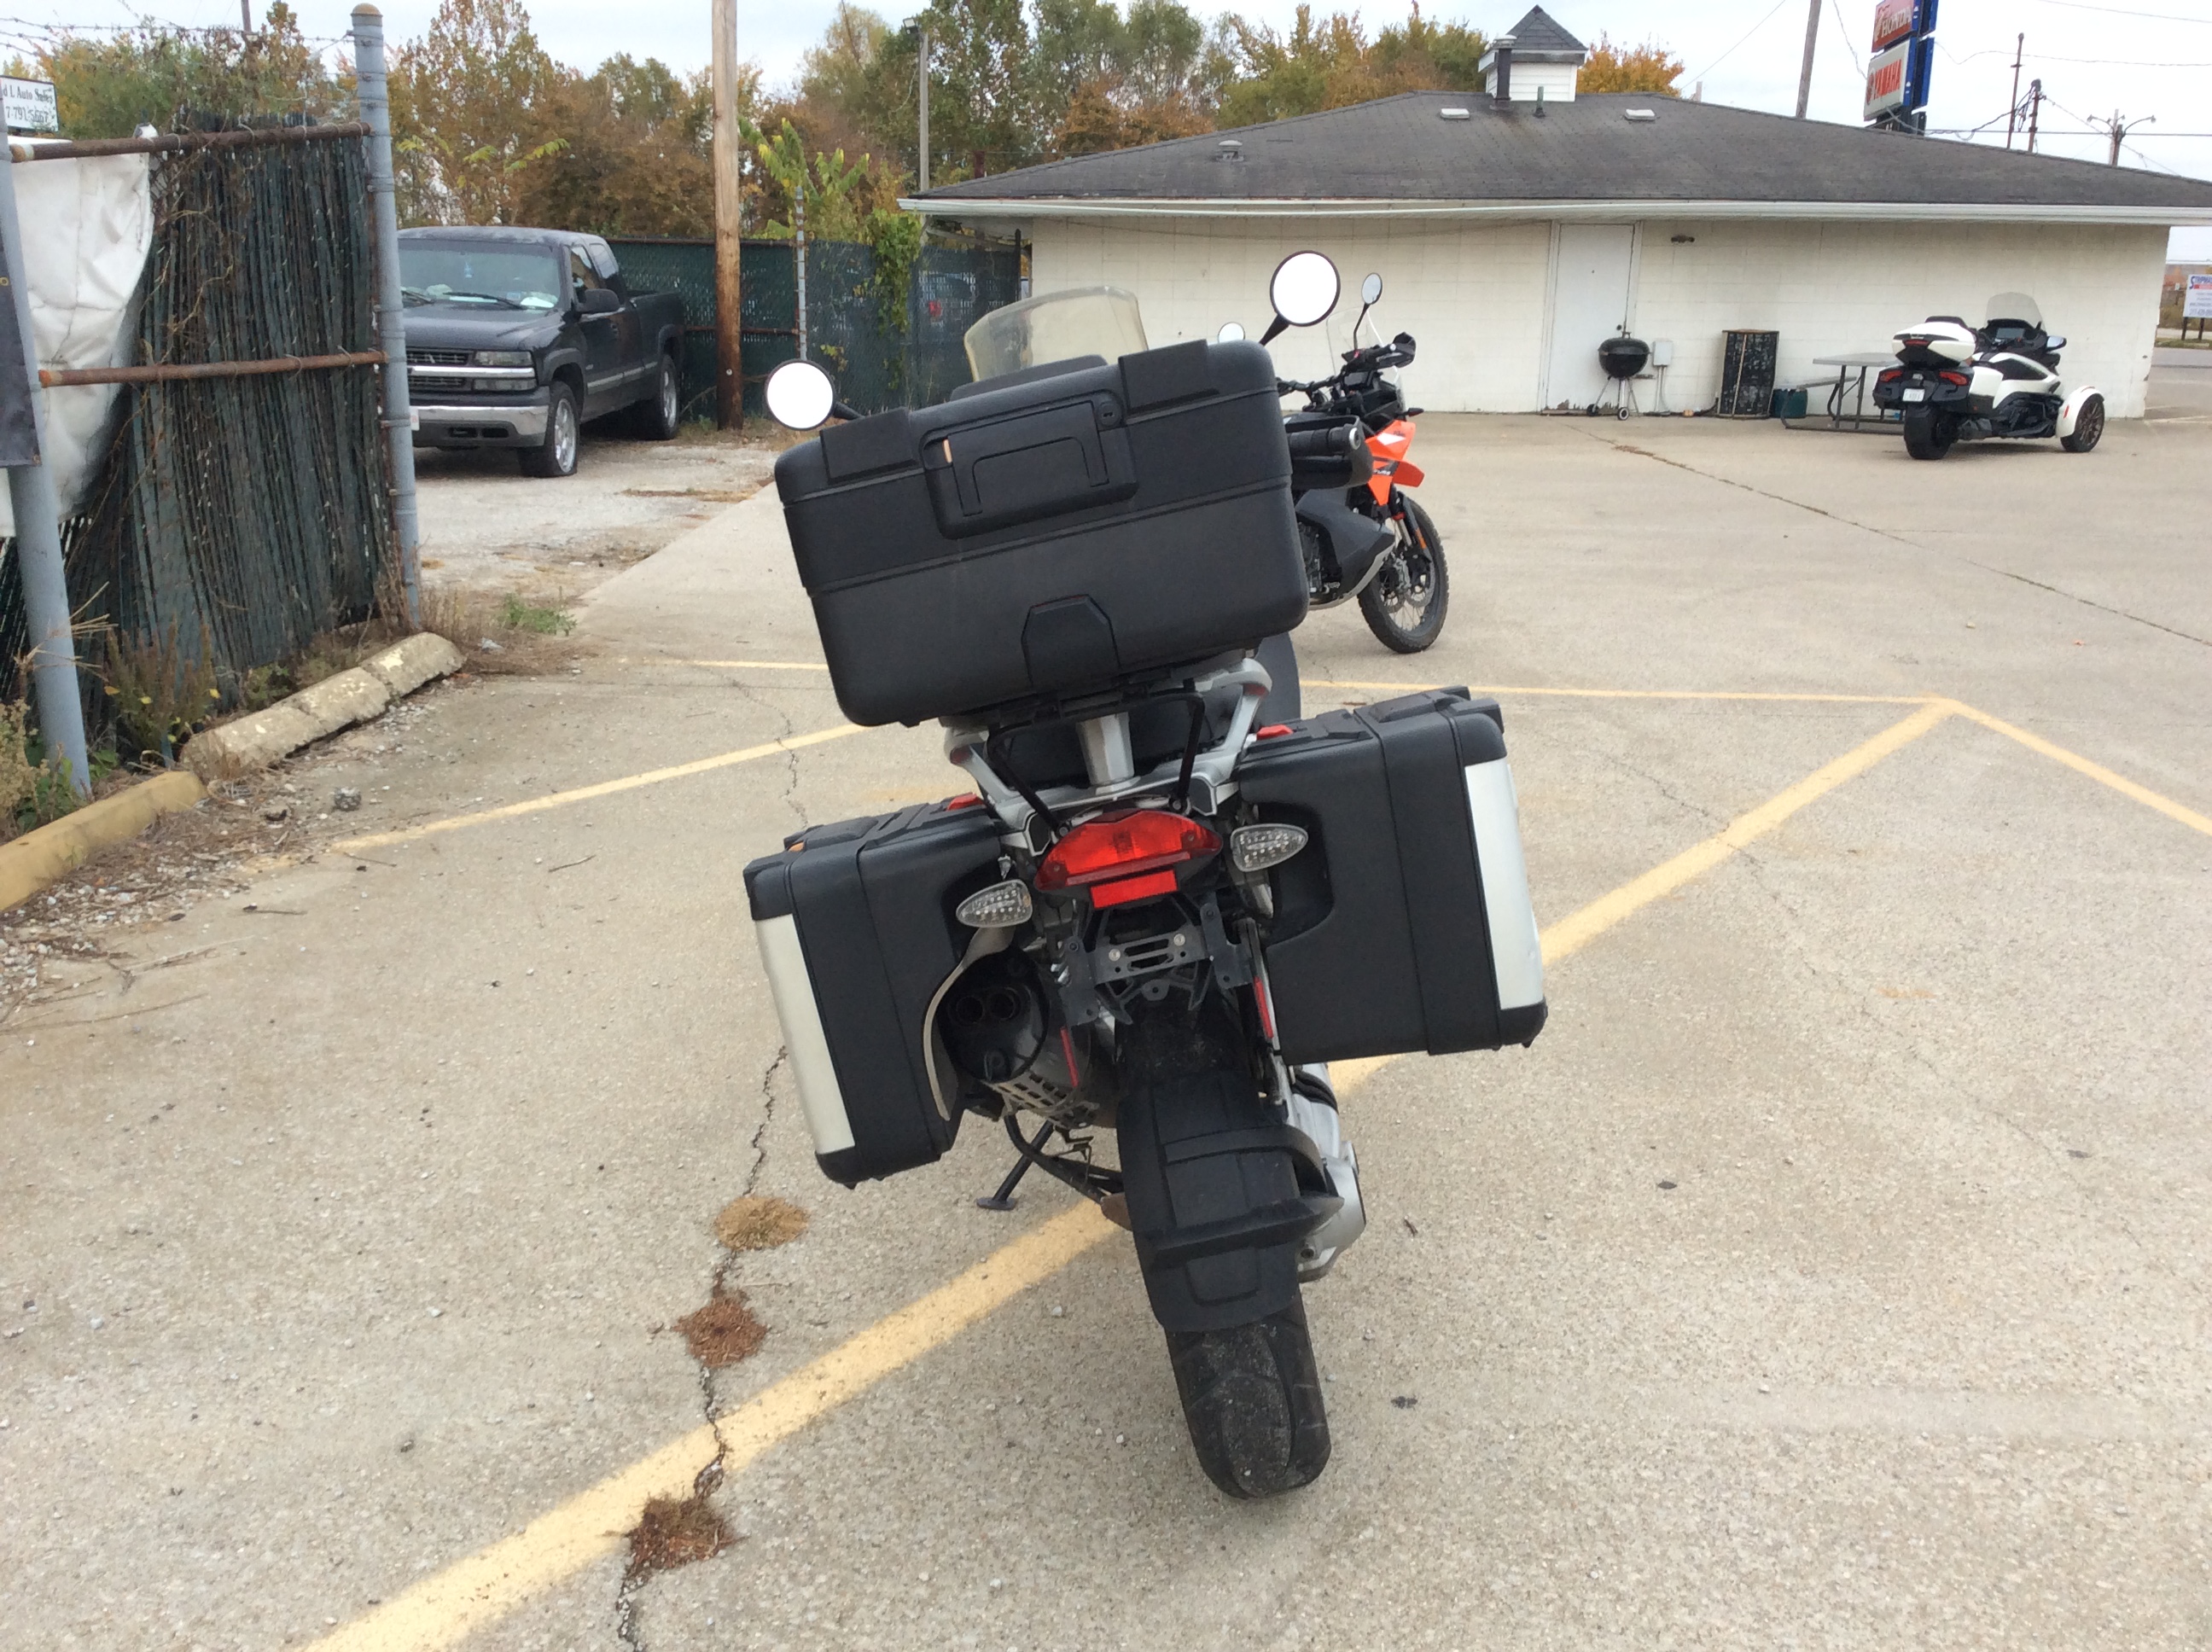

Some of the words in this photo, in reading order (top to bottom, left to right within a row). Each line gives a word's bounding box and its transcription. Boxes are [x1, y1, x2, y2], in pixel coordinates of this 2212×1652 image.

[1881, 7, 1912, 38] HONDA
[9, 84, 15, 97] L
[16, 85, 33, 100] Auto
[1873, 59, 1902, 100] YAMAHA
